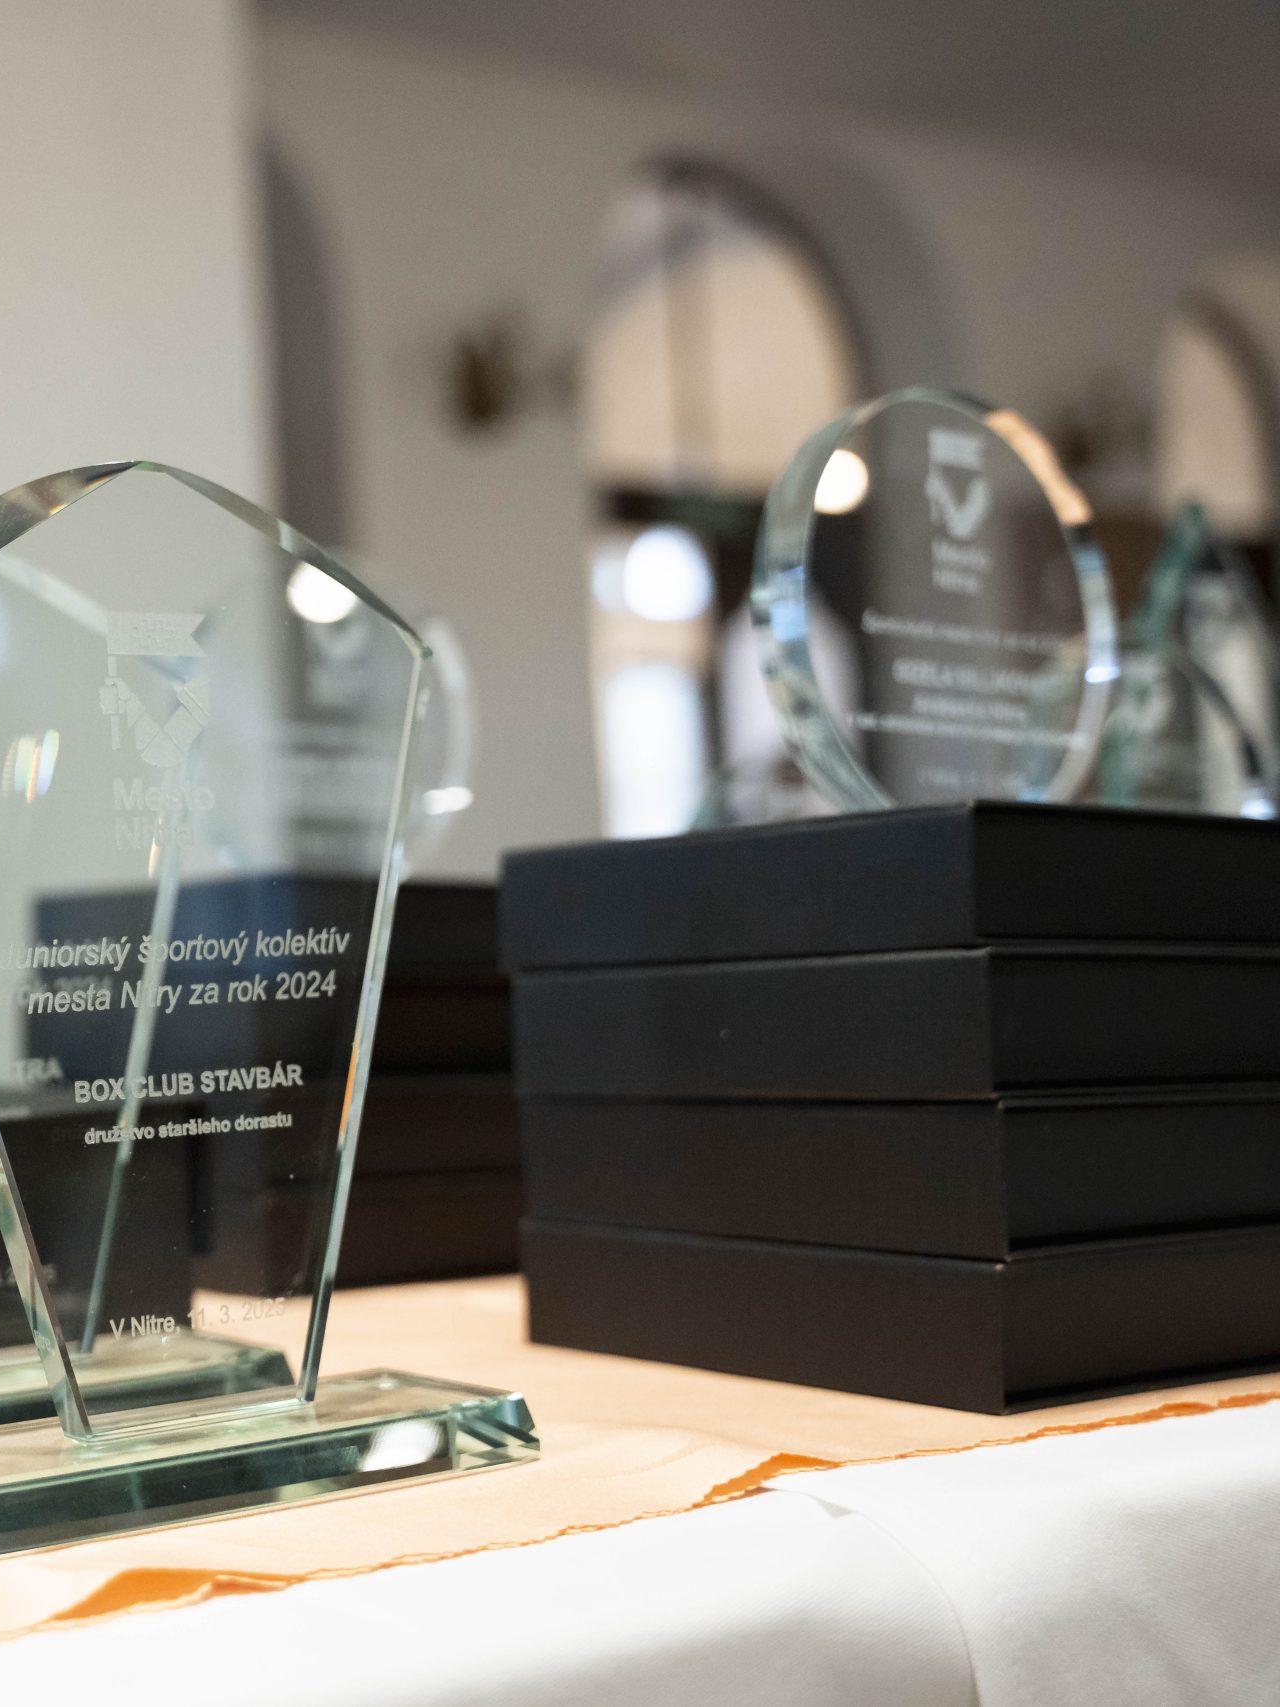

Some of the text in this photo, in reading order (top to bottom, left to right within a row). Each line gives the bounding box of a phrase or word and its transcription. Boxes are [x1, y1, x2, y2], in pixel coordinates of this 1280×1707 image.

[138, 930, 249, 966] športový
[255, 926, 351, 957] kolektív
[27, 983, 112, 1015] mesta
[120, 978, 183, 1014] Ntry
[188, 981, 220, 1005] za
[227, 973, 269, 1003] rok
[275, 968, 337, 1000] 2024
[74, 1060, 304, 1104] BOX CLUB STAVBÁR
[84, 1110, 293, 1145] družtvo staršieho dorastu
[109, 1296, 286, 1341] V Nitre, 11. 3. 2025
